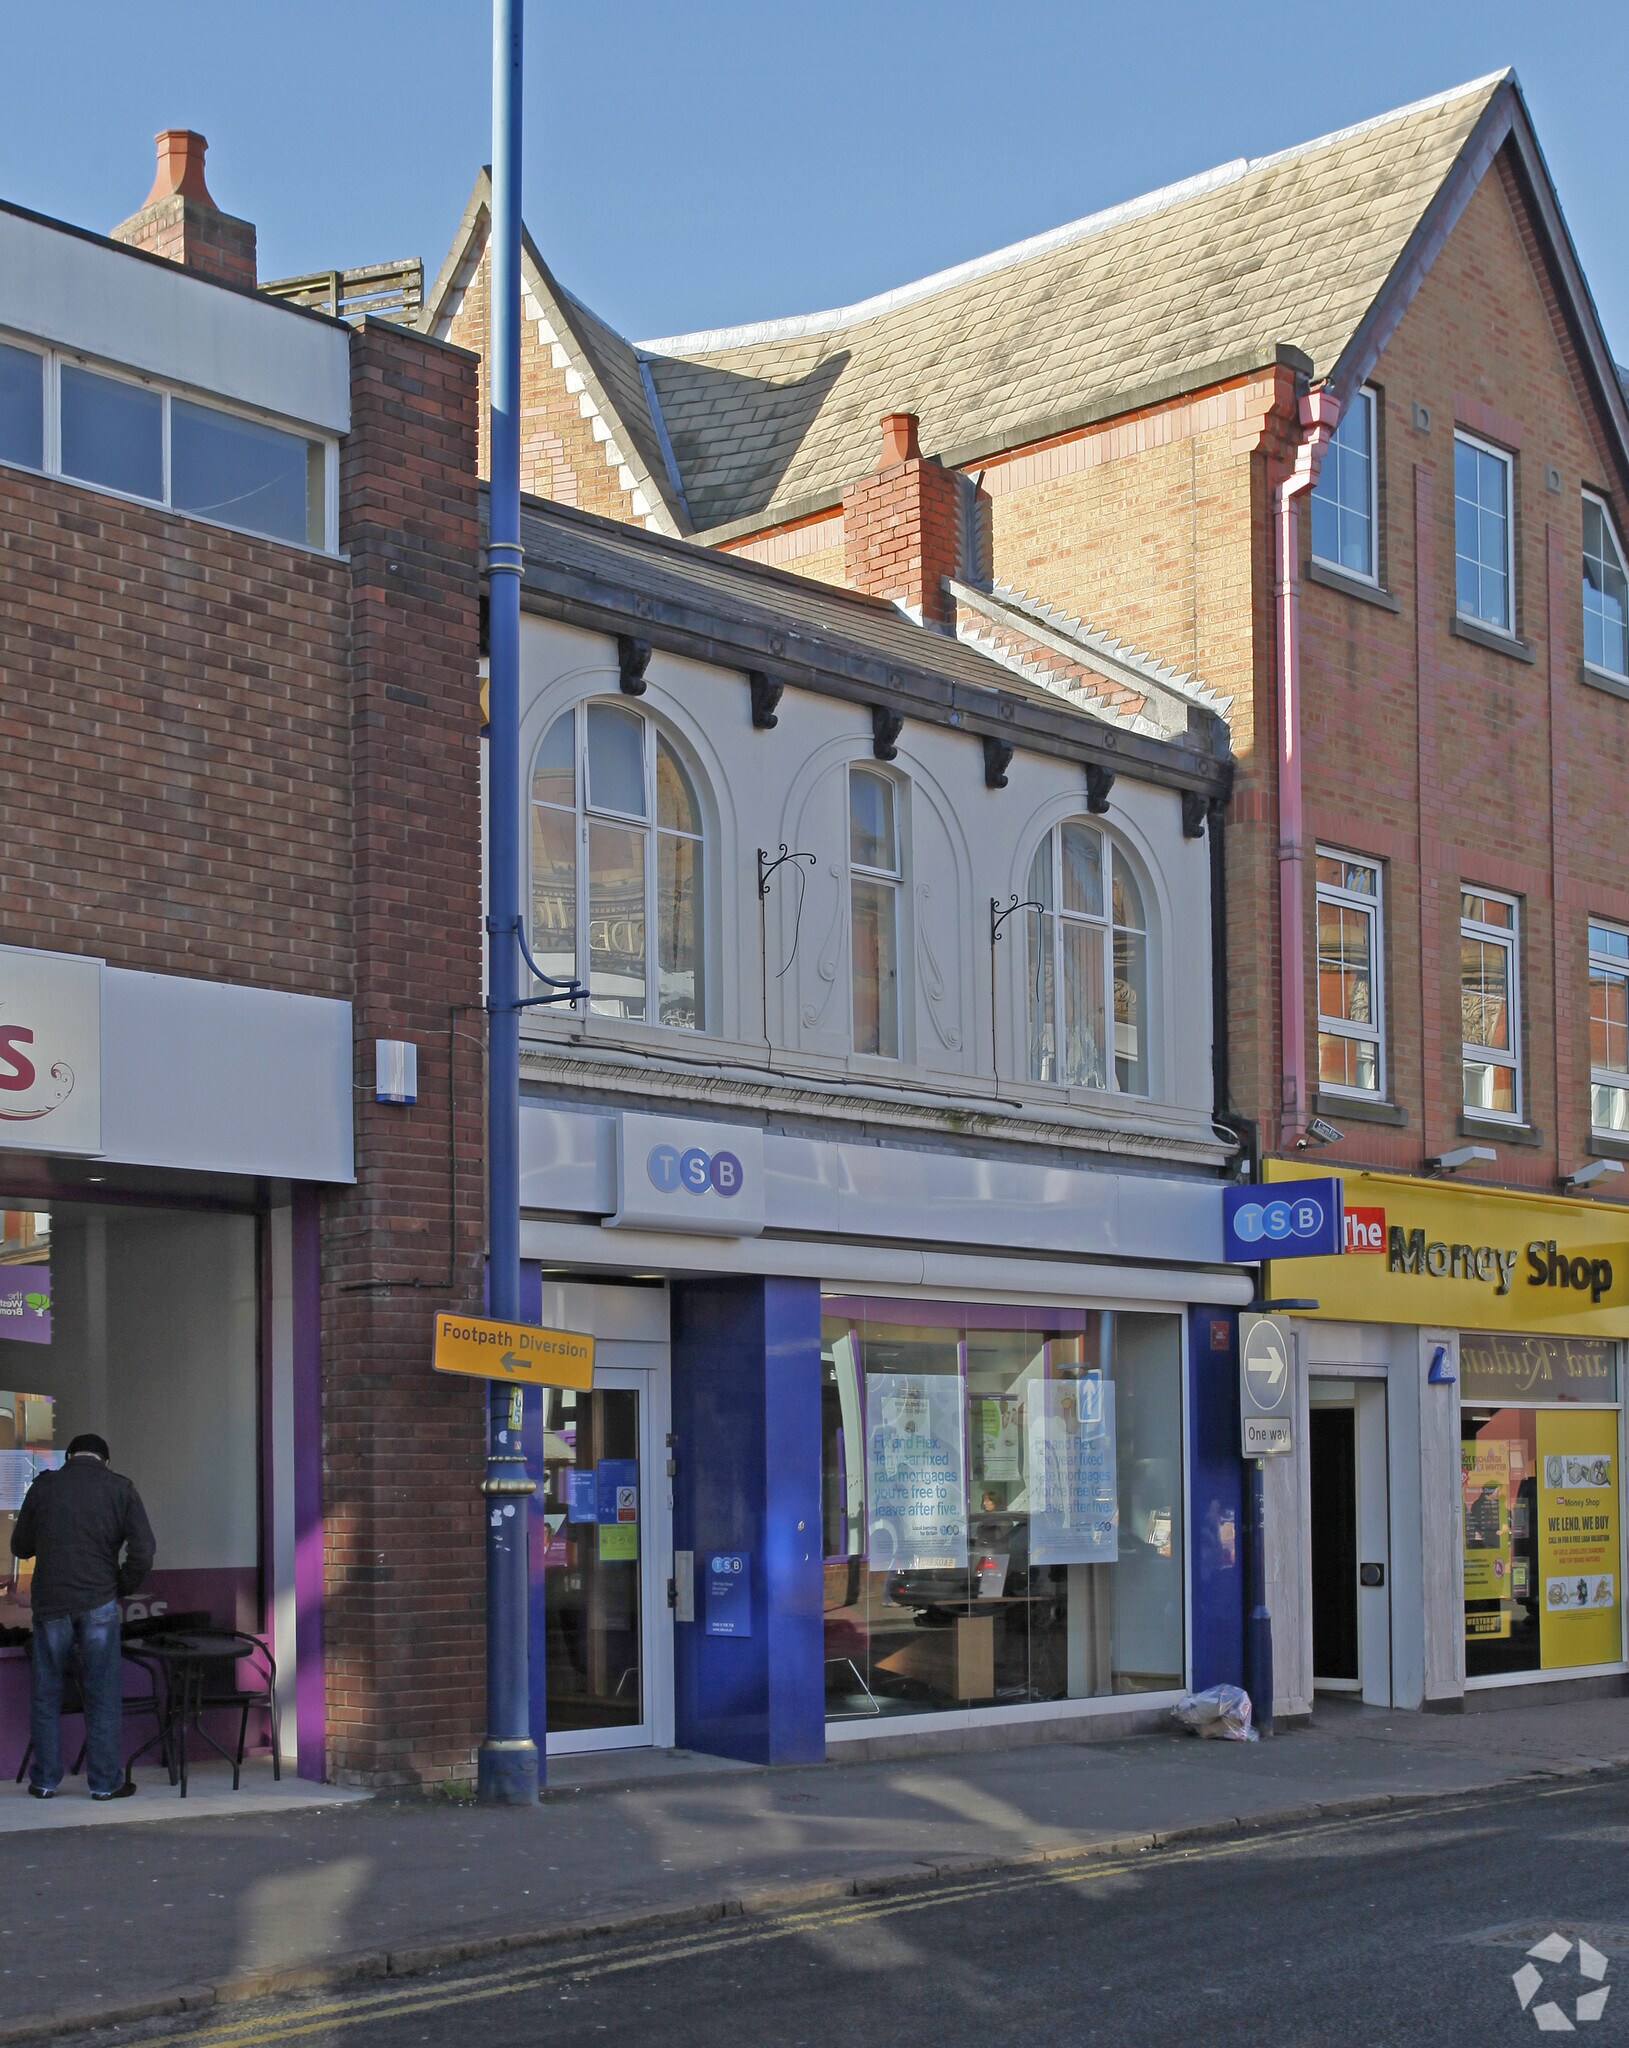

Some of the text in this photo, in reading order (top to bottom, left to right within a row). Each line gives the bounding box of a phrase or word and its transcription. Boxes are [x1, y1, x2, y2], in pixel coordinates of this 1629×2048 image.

[659, 1154, 736, 1187] TSB
[1243, 1206, 1314, 1233] TSB
[1344, 1213, 1613, 1303] The Money Shop
[443, 1321, 588, 1359] Footpath Diversion
[874, 1433, 941, 1449] Fix and Flex.
[1248, 1426, 1287, 1443] One way
[922, 1451, 949, 1466] fixed
[1079, 1453, 1104, 1466] fixed
[1485, 1463, 1507, 1471] WINTER
[898, 1469, 958, 1485] mortgages
[1058, 1469, 1112, 1484] mortgages
[874, 1485, 947, 1502] you're free to
[1069, 1485, 1089, 1497] free
[1091, 1486, 1102, 1497] to
[875, 1501, 960, 1517] leave after five.
[1565, 1499, 1584, 1508] Money
[1585, 1497, 1600, 1508] Shop
[1548, 1515, 1609, 1532] WE LEND, WE BUY
[715, 1560, 740, 1570] TSB
[1475, 1624, 1496, 1632] UNION
